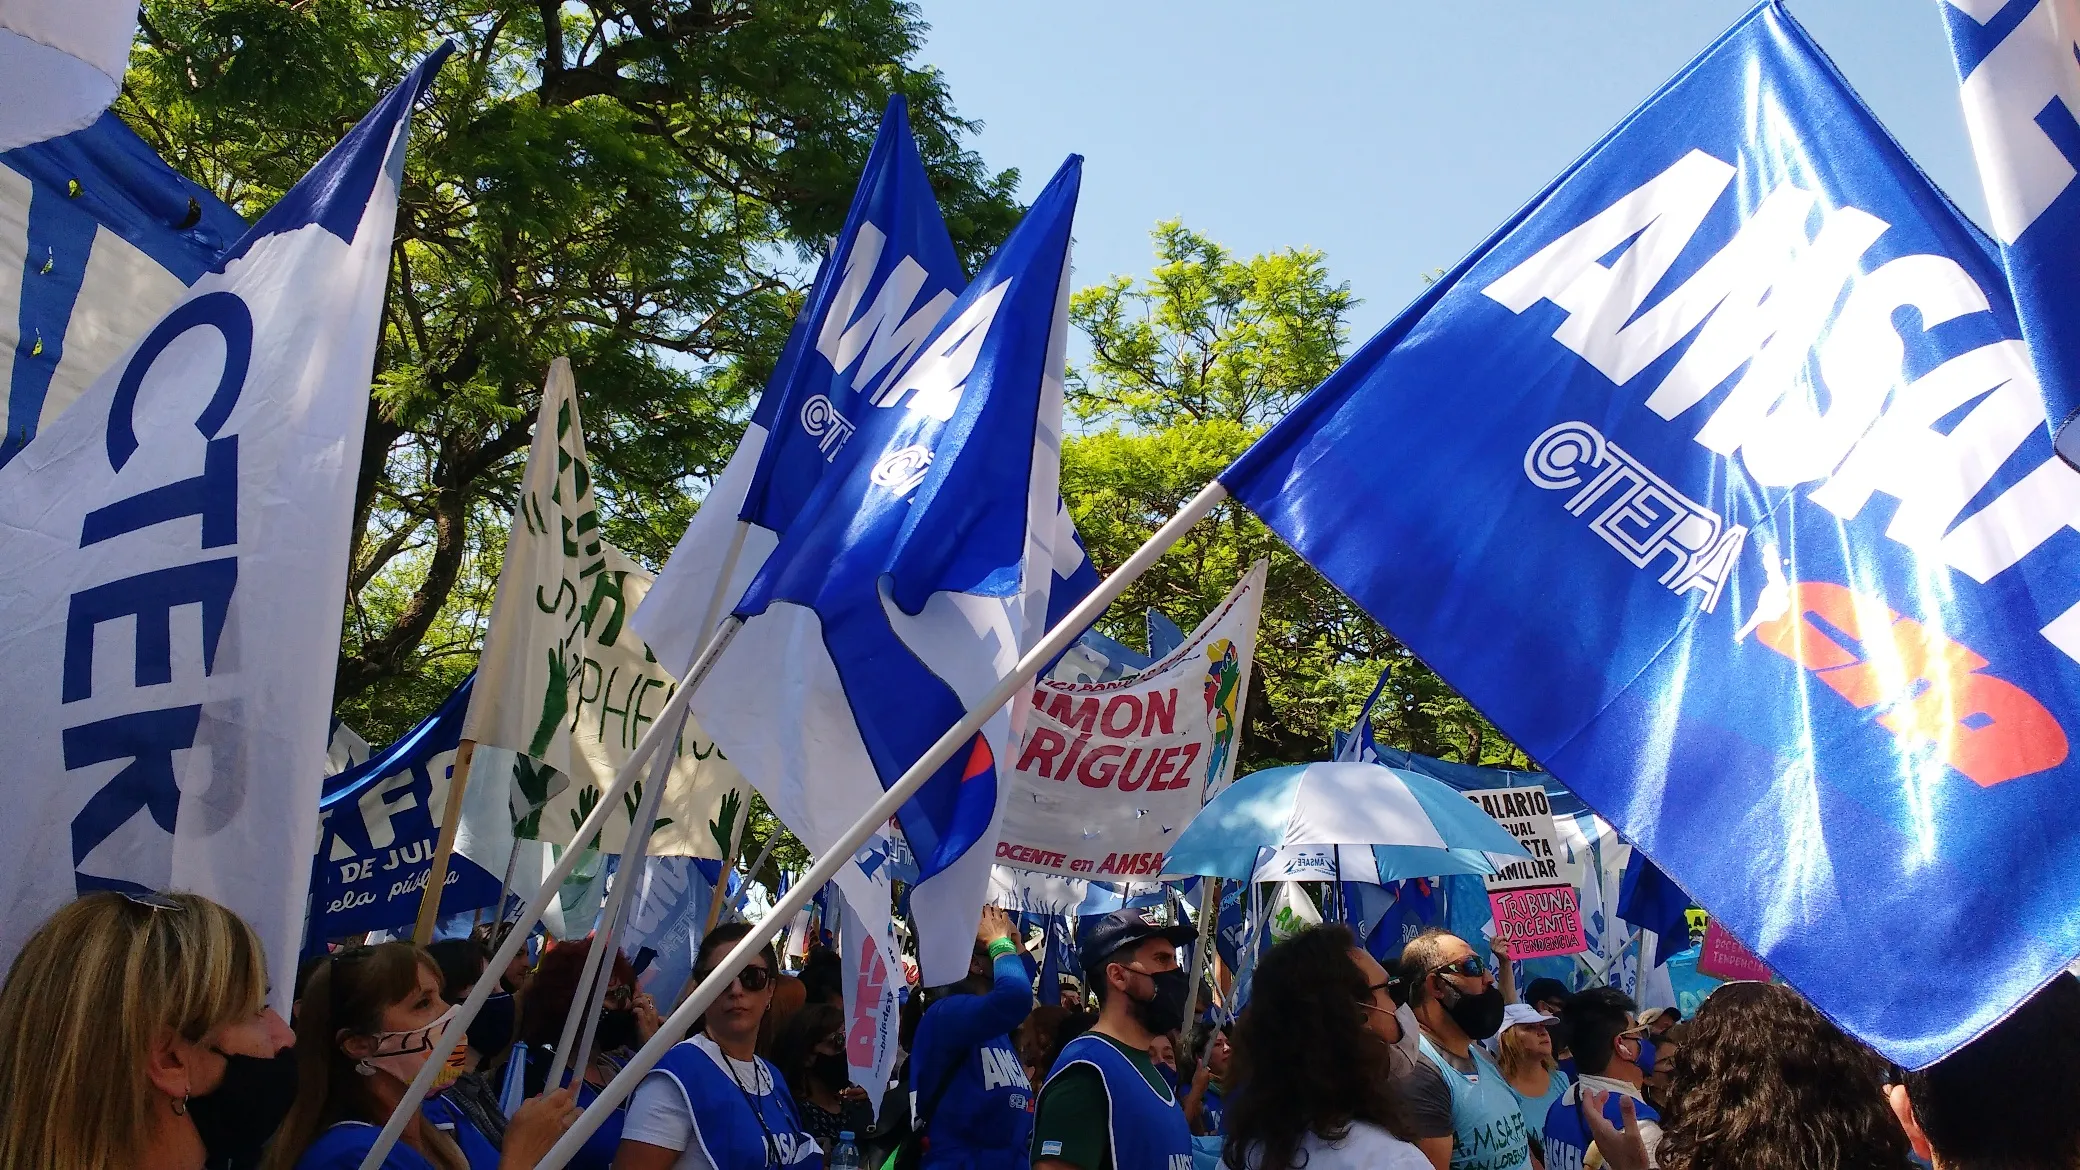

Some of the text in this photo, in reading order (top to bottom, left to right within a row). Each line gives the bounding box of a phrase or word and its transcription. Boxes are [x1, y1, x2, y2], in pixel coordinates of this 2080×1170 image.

[1523, 420, 1748, 614] CTERA
[62, 291, 253, 895] CTER
[340, 857, 377, 884] DE
[1069, 858, 1094, 874] en
[1497, 889, 1576, 919] TRIBUNA
[1500, 913, 1578, 941] DOCENTE
[1512, 933, 1580, 954] TENDENCIA
